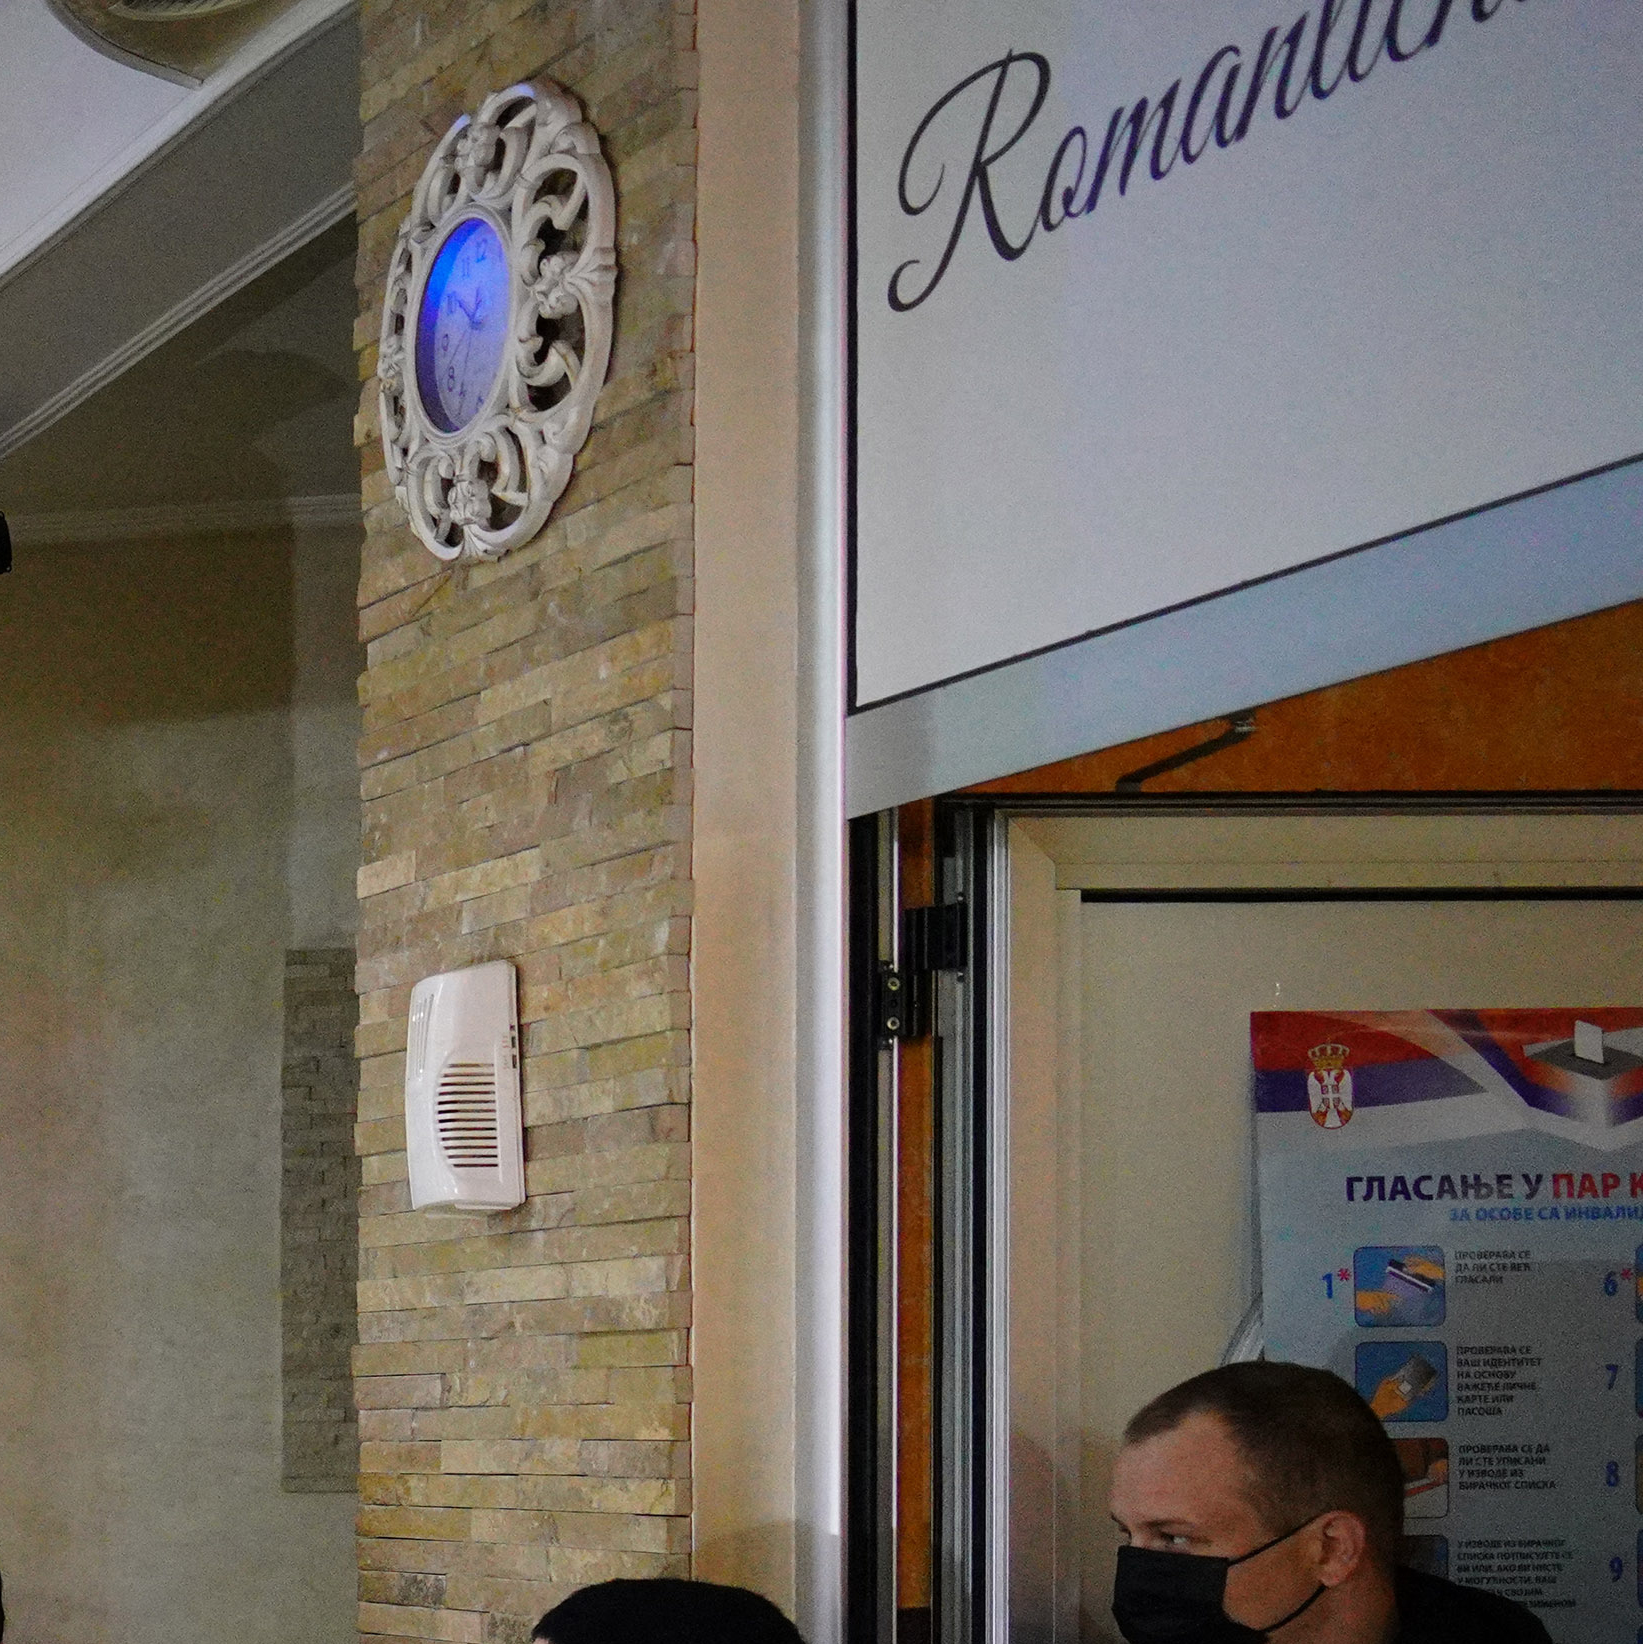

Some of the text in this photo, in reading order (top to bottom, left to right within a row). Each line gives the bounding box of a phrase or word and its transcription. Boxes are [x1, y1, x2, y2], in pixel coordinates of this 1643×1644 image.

[1346, 1173, 1514, 1202] ГЛАСАЊЕ
[1521, 1173, 1543, 1199] У
[1552, 1172, 1621, 1199] ПАР
[1449, 1208, 1469, 1222] ЗА
[1475, 1206, 1534, 1221] ОСОБЕ
[1538, 1206, 1560, 1221] СА
[1518, 1250, 1531, 1259] СЕ
[1456, 1346, 1531, 1355] ПРОВЕРАВА СЕ
[1456, 1358, 1542, 1368] ВАШ ИДЕНТИТЕТ
[1456, 1370, 1516, 1379] НА ОСНОВУ
[1605, 1363, 1619, 1390] 7
[1456, 1394, 1514, 1404] КАРТЕ ИЛИ
[1458, 1407, 1502, 1416] ПАСОША
[1459, 1443, 1550, 1454] ПРОВЕРАВА СЕ ДА
[1459, 1456, 1546, 1466] ЛИ СТЕ УПИСАНИ
[1605, 1460, 1619, 1487] 8
[1459, 1480, 1556, 1490] БИРАЧКОГ СПИСКА
[1608, 1556, 1623, 1582] 9
